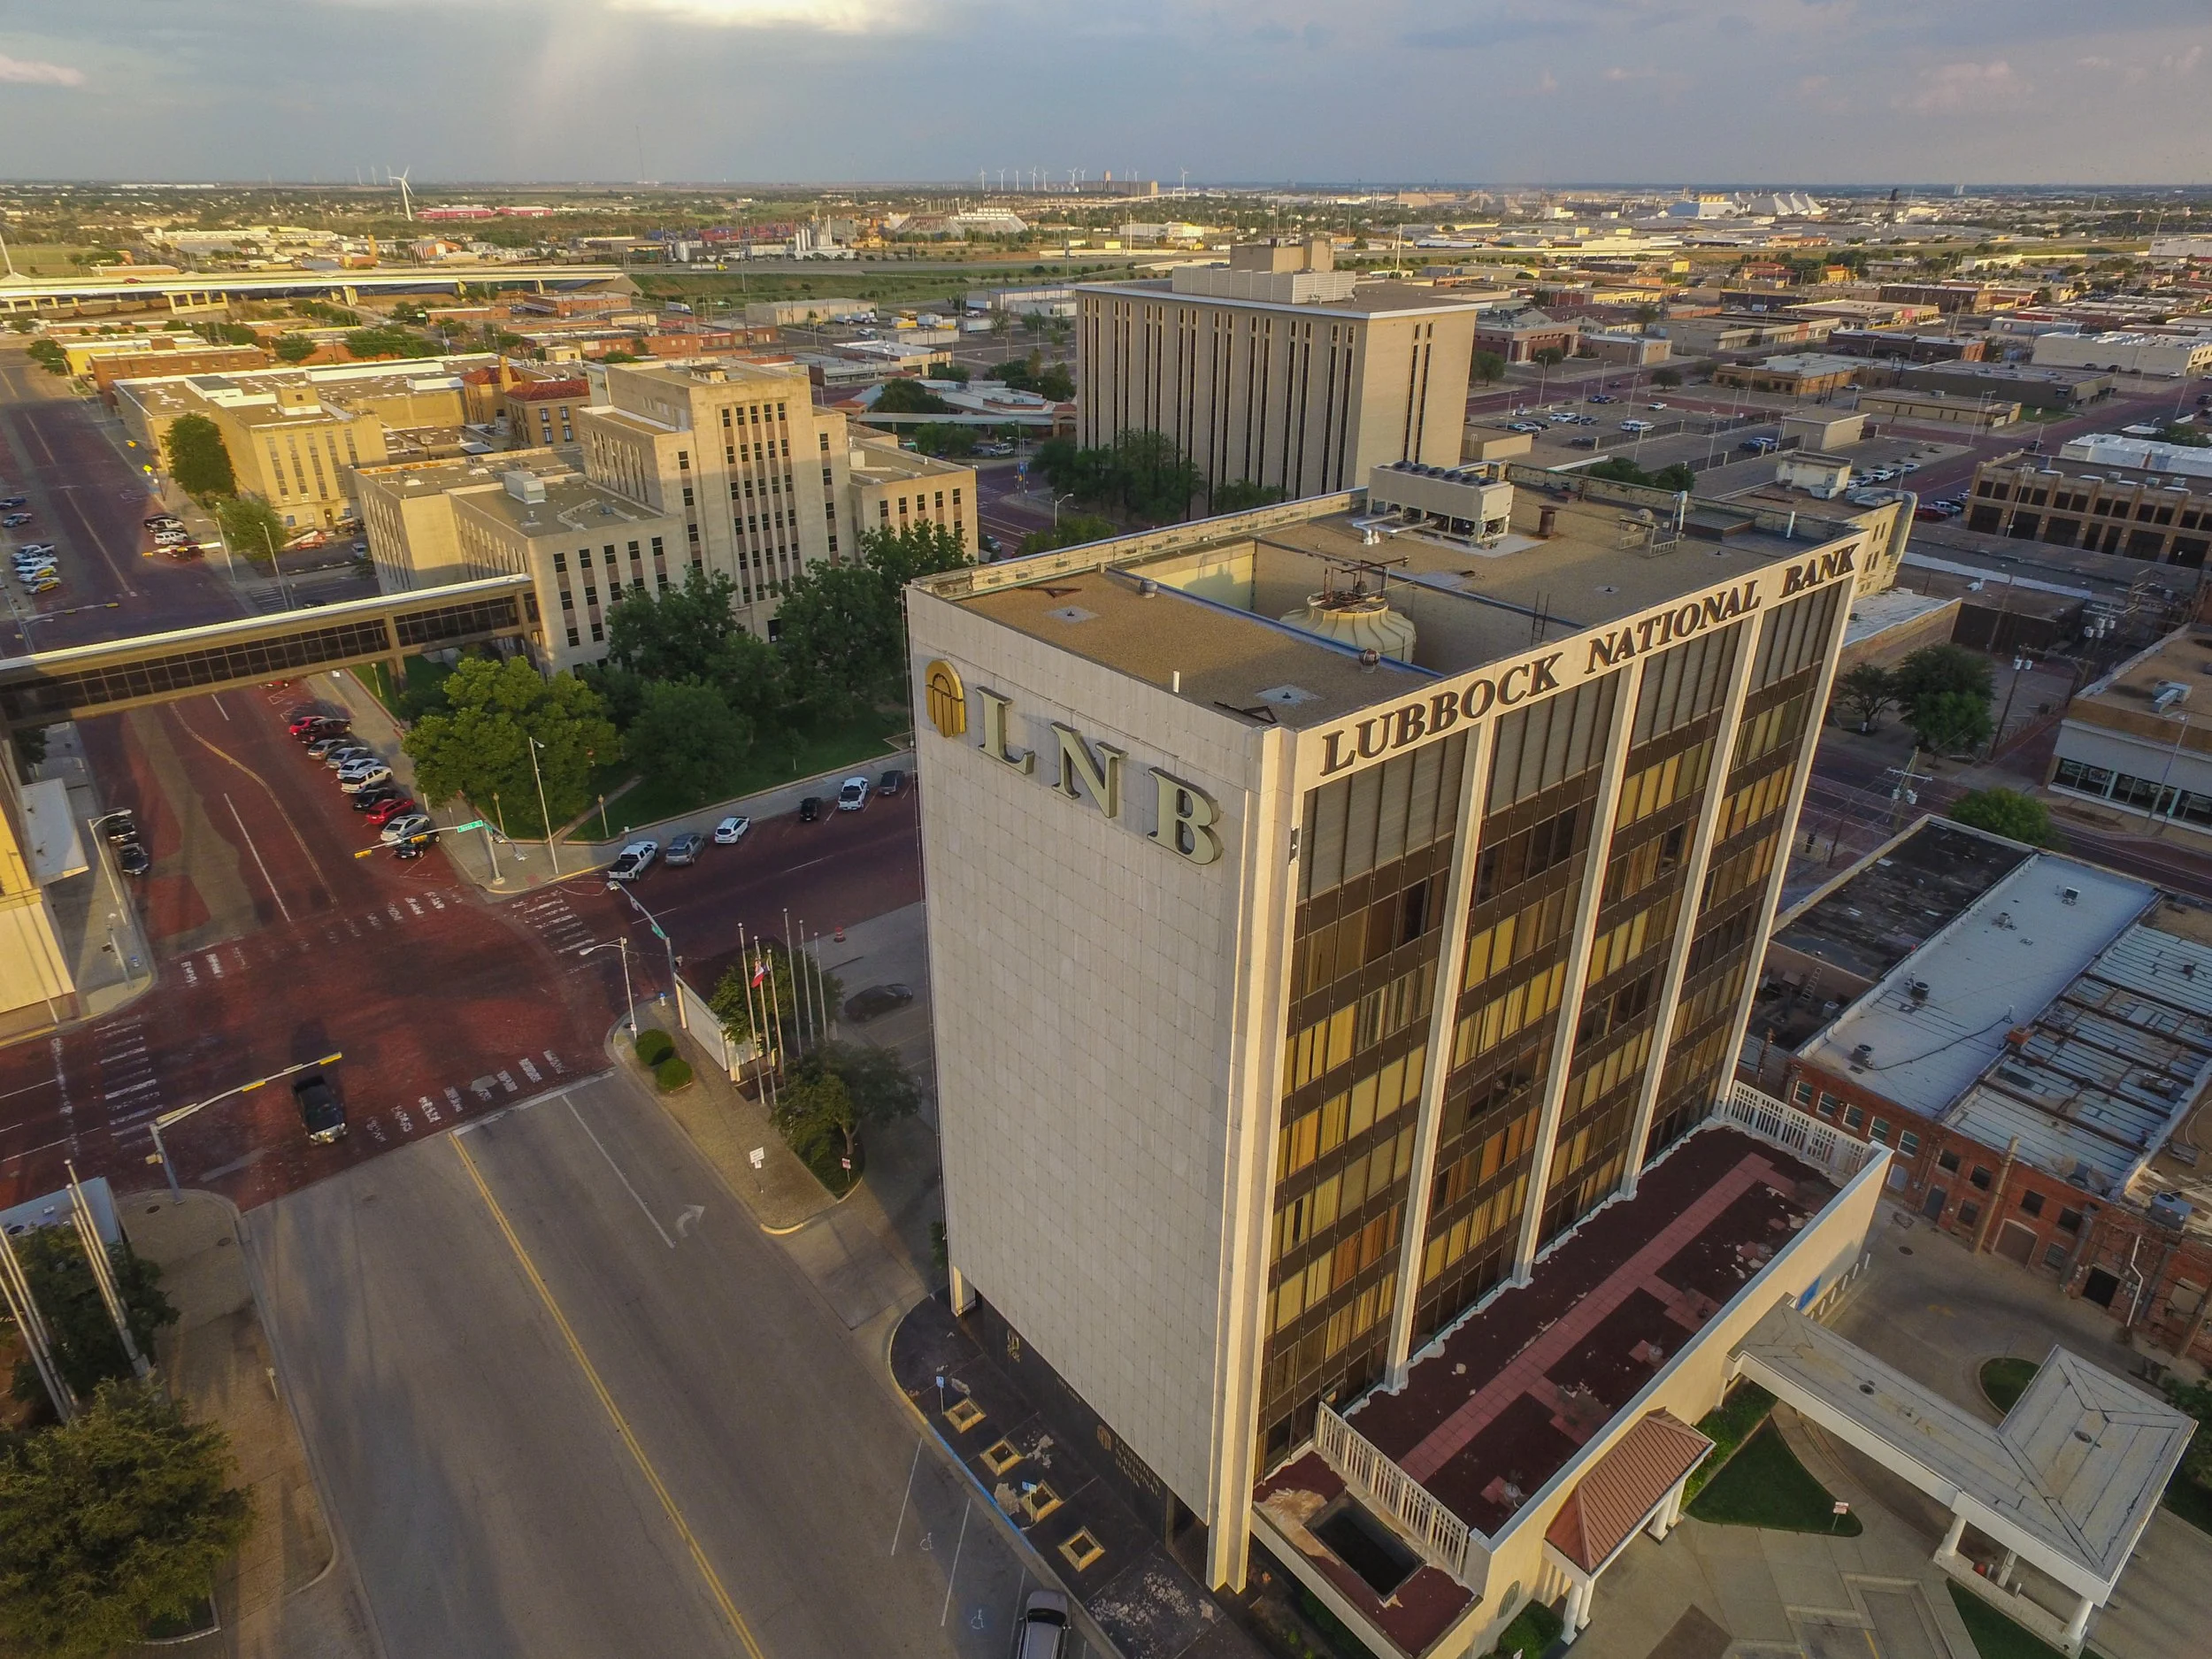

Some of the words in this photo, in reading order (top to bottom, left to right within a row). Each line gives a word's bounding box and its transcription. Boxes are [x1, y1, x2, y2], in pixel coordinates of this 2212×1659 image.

[1319, 651, 1564, 777] LUBBOCK
[1584, 579, 1762, 674] NATIONAL
[1778, 542, 1860, 599] BANK
[976, 686, 1223, 865] LNB
